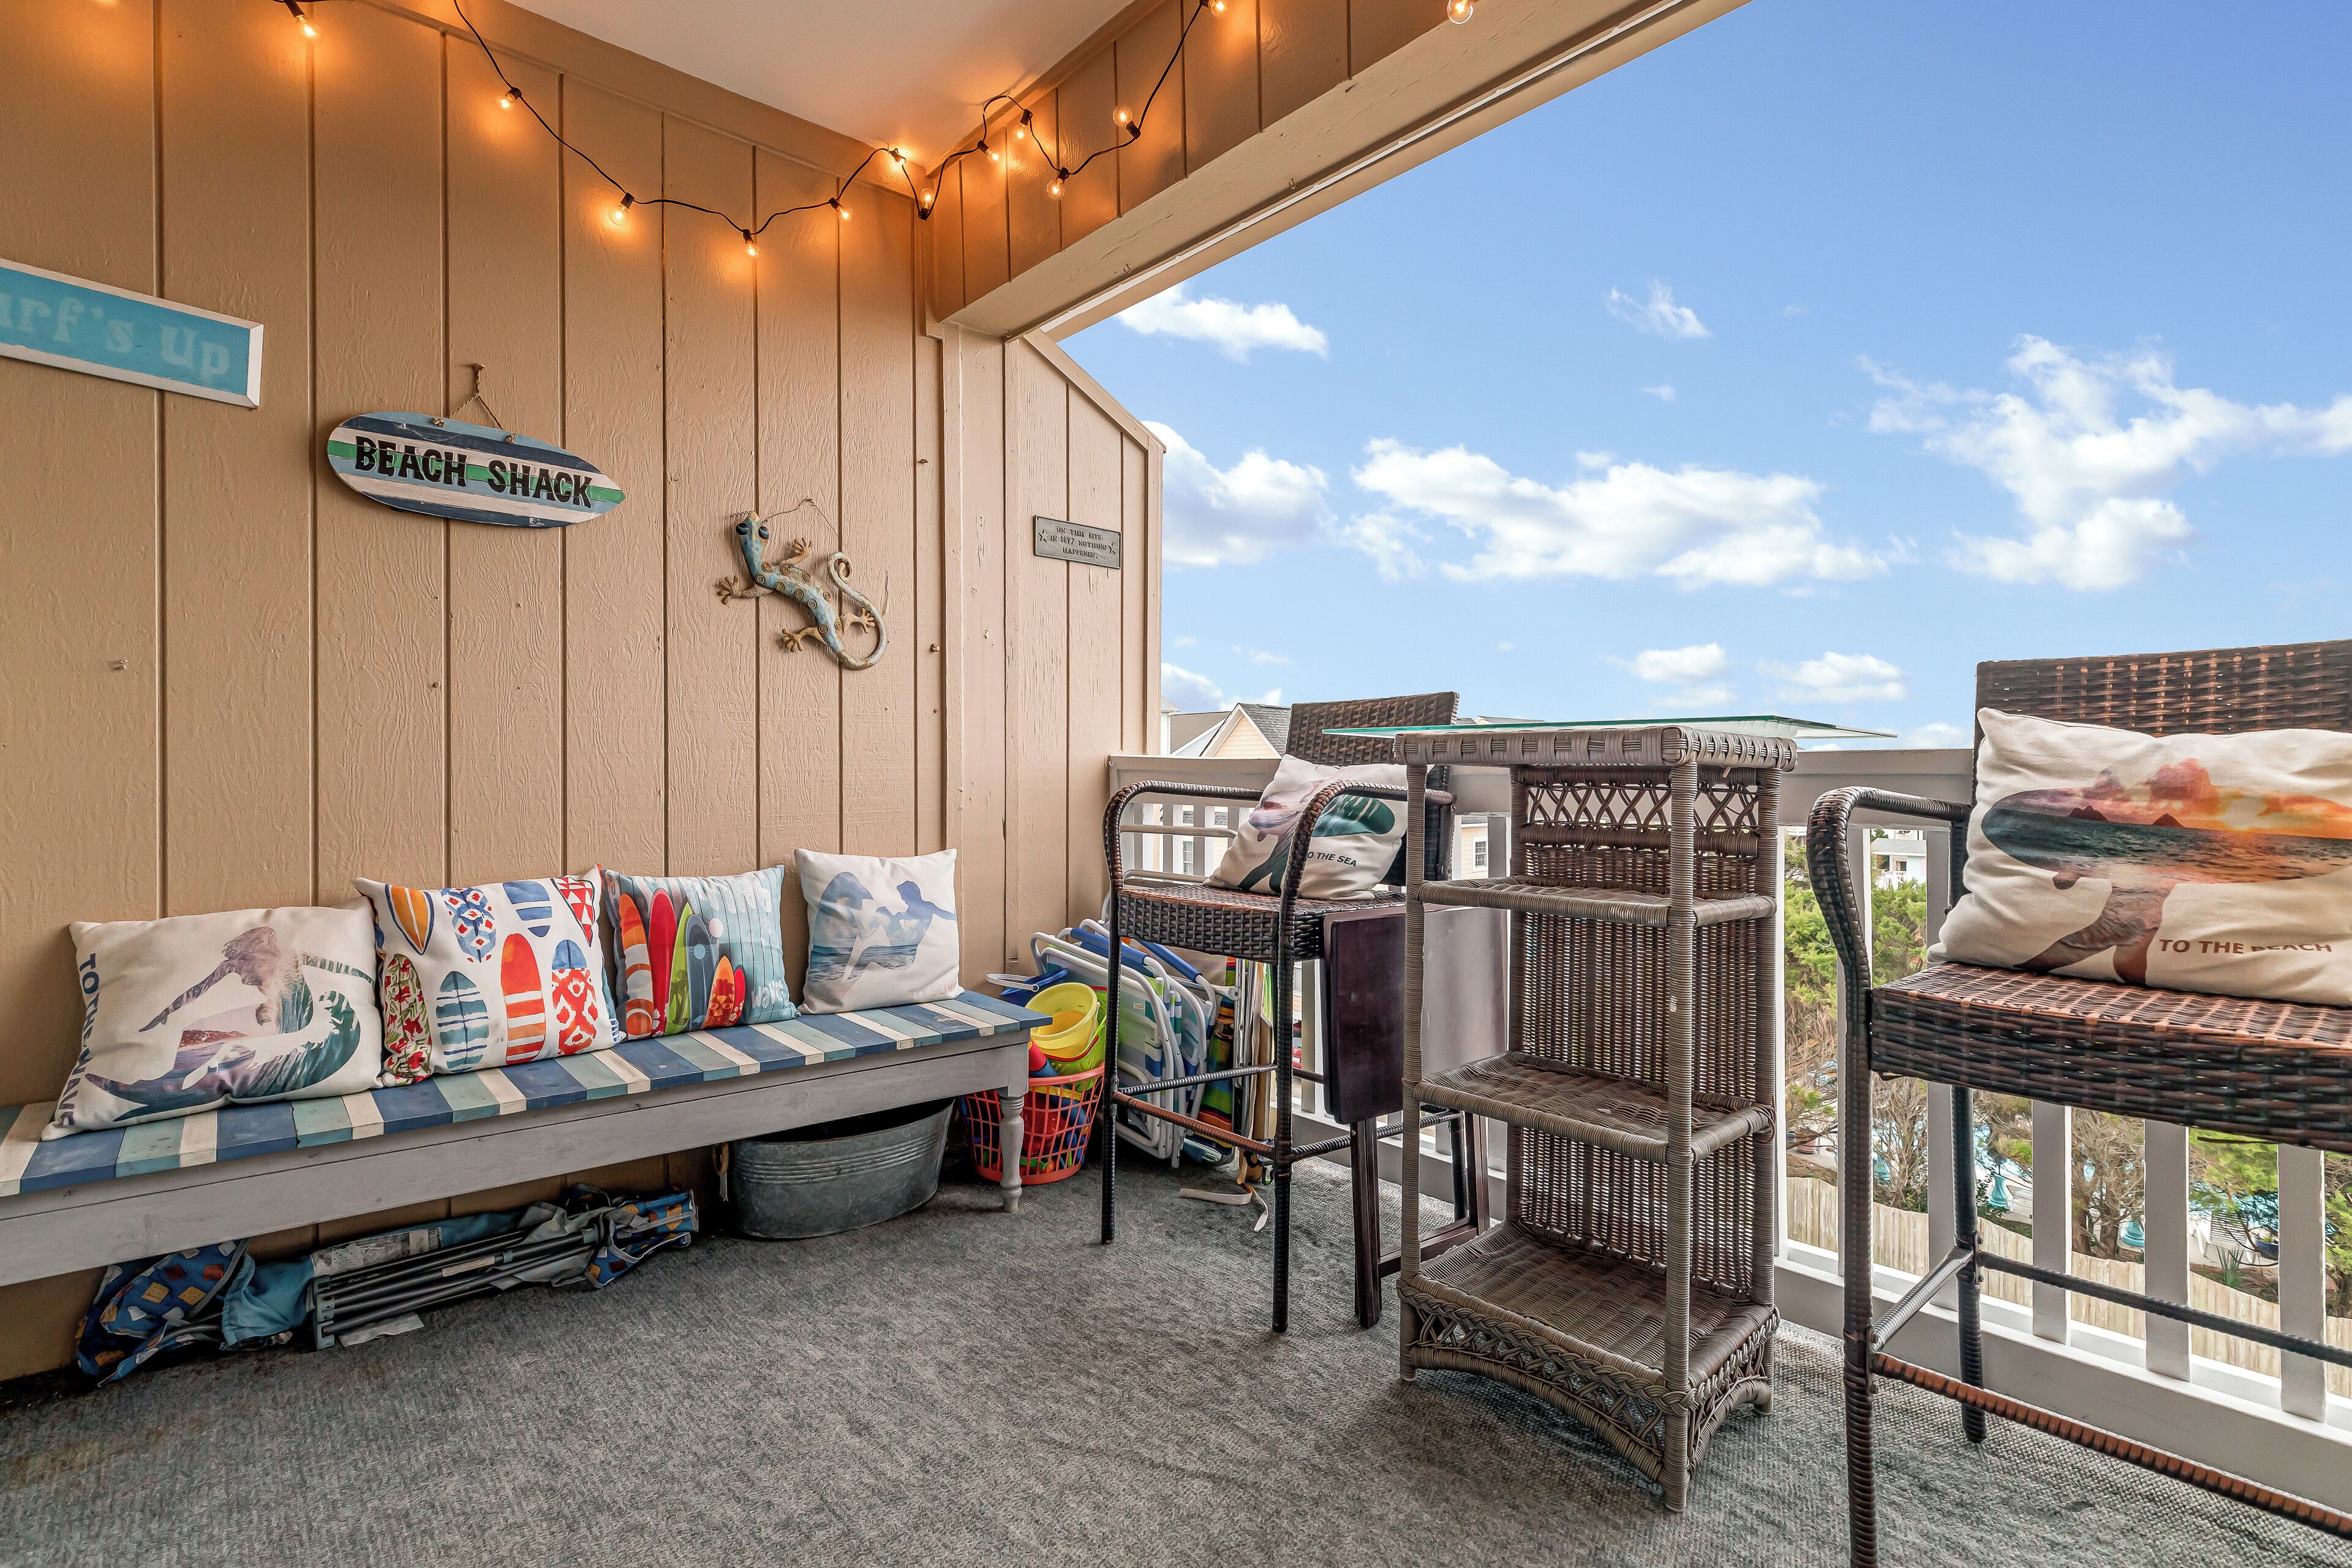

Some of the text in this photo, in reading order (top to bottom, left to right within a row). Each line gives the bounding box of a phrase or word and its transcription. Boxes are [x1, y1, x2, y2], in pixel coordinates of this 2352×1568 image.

[355, 435, 594, 509] BEACH SHACK
[1056, 526, 1066, 534] ON
[1070, 529, 1085, 537] THIS
[1060, 535, 1075, 545] 1897
[1078, 539, 1107, 551] NOTHING
[1317, 852, 1336, 861] THE
[1336, 855, 1357, 867] SEA
[2159, 938, 2190, 953] TO
[2198, 940, 2244, 954] THE
[79, 952, 100, 995] TO
